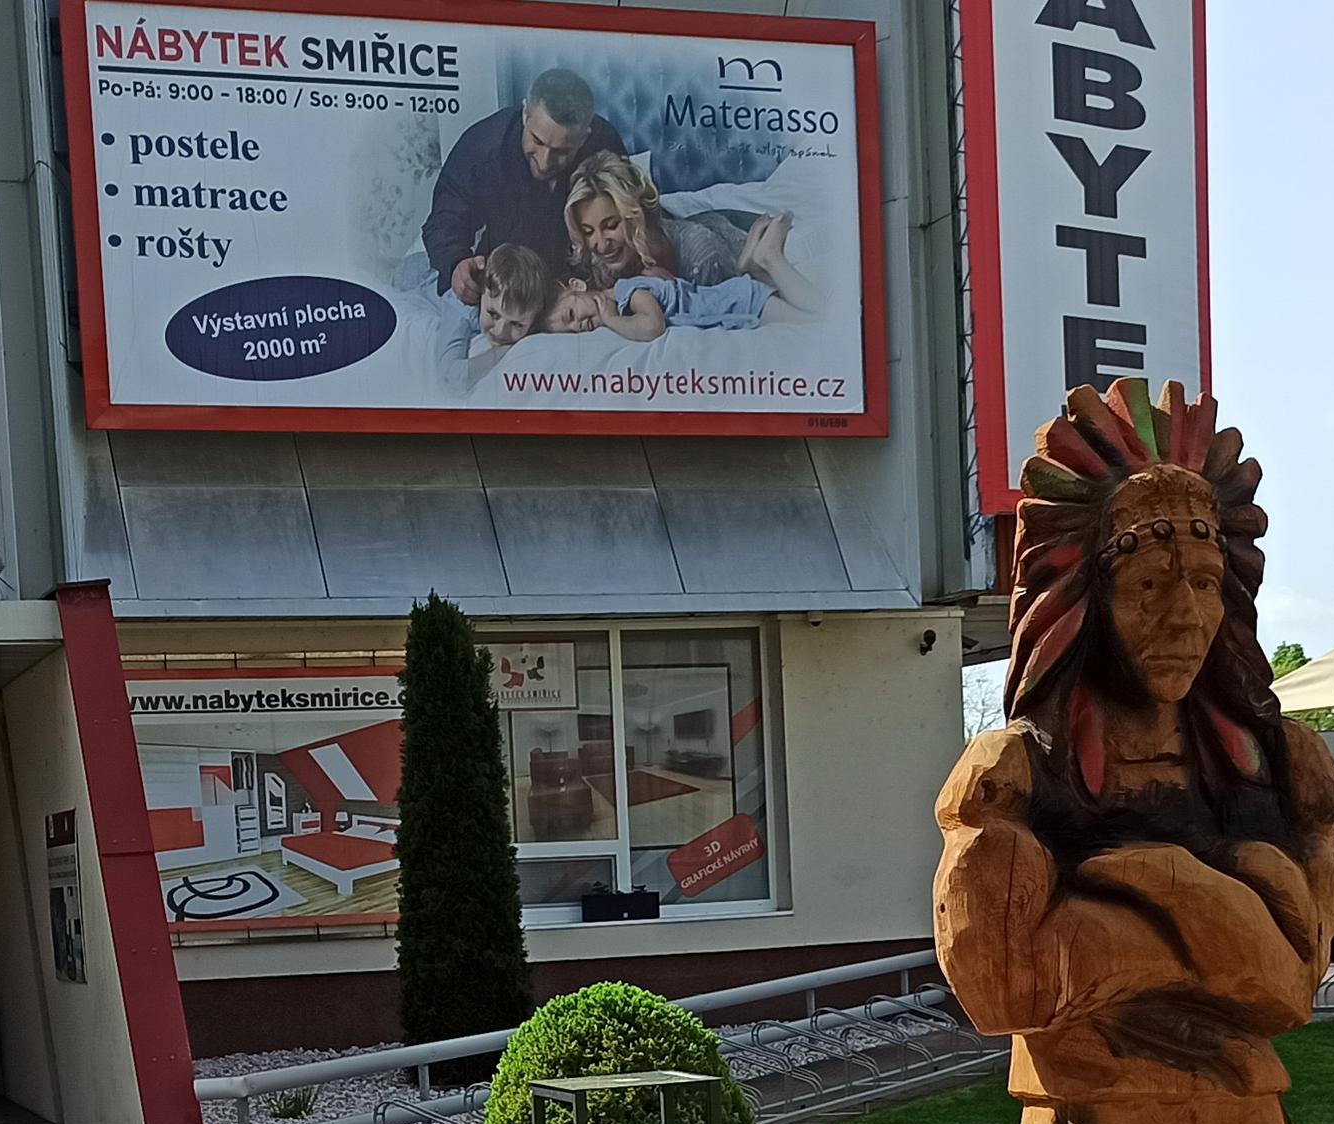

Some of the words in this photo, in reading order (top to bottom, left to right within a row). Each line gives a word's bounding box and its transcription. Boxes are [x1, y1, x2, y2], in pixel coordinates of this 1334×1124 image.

[95, 17, 289, 69] NÁBYTEK
[301, 32, 459, 79] SMIŘICE
[98, 79, 162, 99] Po-Pá:
[168, 83, 213, 101] 9:00
[236, 87, 287, 106] 18:00
[310, 91, 339, 108] So:
[345, 93, 388, 111] 9:00
[410, 97, 460, 114] 12:00
[665, 94, 839, 134] Materasso
[129, 130, 260, 164] postele
[134, 181, 289, 212] matrace
[137, 227, 232, 268] rošty
[192, 306, 288, 338] Výstavní
[295, 301, 366, 328] plocha
[243, 337, 295, 361] 2000
[504, 368, 845, 400] www.nabyteksmirice.cz
[131, 688, 407, 713] ww.nabyteksmirice.c
[680, 858, 724, 889] GRAFICKÉ
[723, 838, 759, 864] NÁVRHY
[703, 841, 722, 857] 3D
